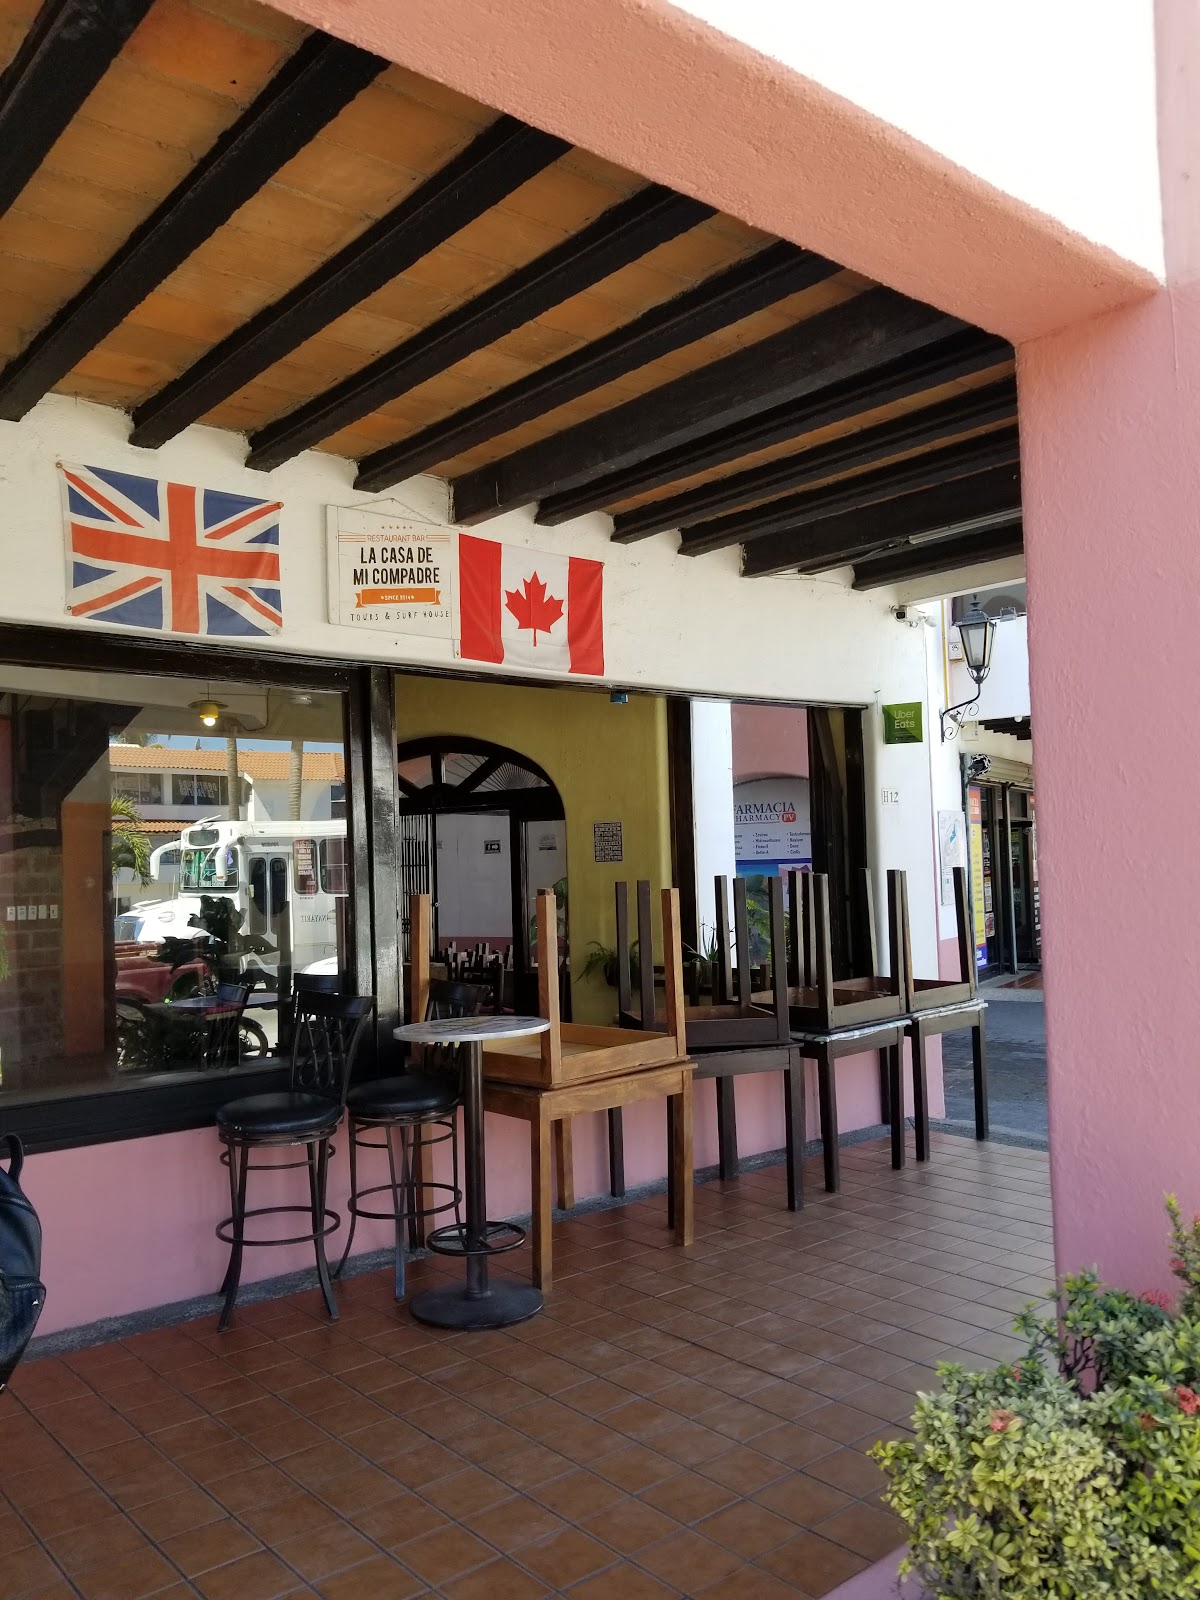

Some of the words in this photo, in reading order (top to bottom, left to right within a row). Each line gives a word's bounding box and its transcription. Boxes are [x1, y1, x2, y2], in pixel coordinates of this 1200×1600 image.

[367, 534, 410, 542] RESTAURANT
[412, 534, 425, 542] BAR
[360, 547, 376, 563] LA
[381, 546, 413, 563] CASA
[417, 546, 433, 563] DE
[353, 568, 368, 585] MI
[372, 567, 440, 585] COMPADRE
[350, 613, 379, 621] TOURS
[384, 611, 391, 619] &
[396, 611, 418, 620] SURF
[894, 709, 915, 719] Uber
[894, 719, 915, 729] Eats
[883, 790, 899, 803] H12
[735, 813, 781, 821] HARMACY
